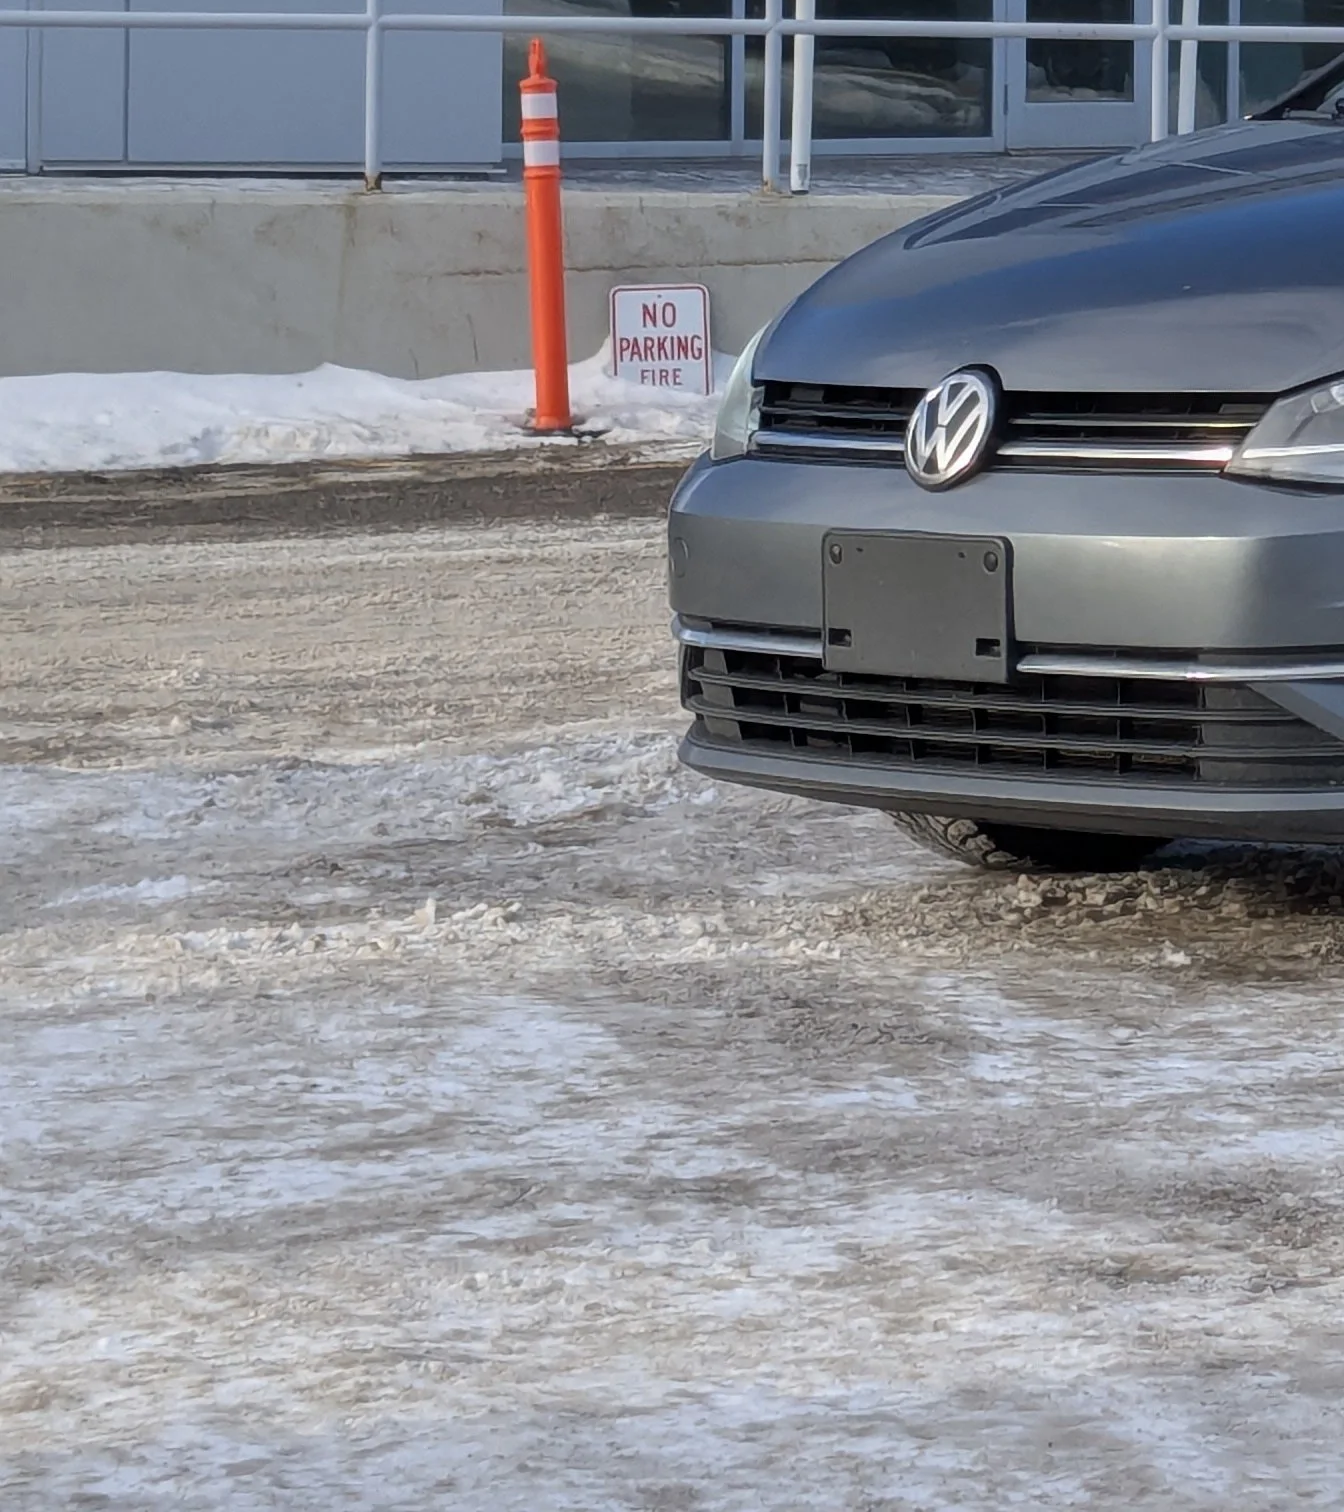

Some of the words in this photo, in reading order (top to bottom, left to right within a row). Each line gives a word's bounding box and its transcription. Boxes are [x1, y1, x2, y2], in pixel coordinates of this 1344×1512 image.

[641, 301, 677, 328] NO
[619, 334, 703, 362] PARKING
[640, 368, 683, 387] FIRE
